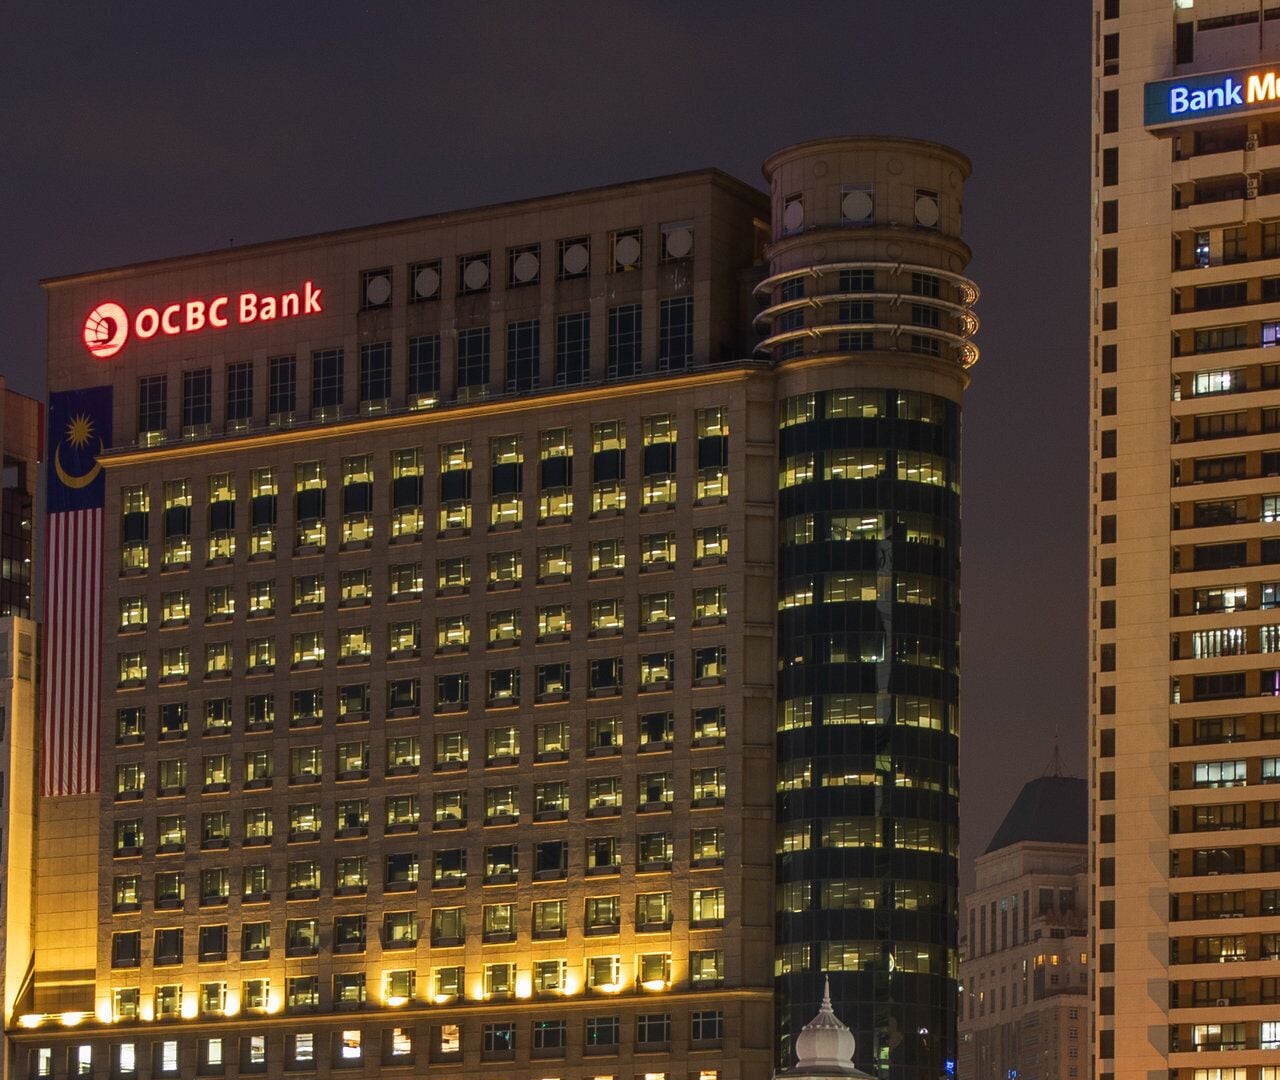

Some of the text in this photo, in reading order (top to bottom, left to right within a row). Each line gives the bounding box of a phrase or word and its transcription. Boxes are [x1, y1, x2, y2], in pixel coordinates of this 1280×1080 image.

[1170, 79, 1243, 114] Bank
[135, 281, 322, 339] OCBC Bank
